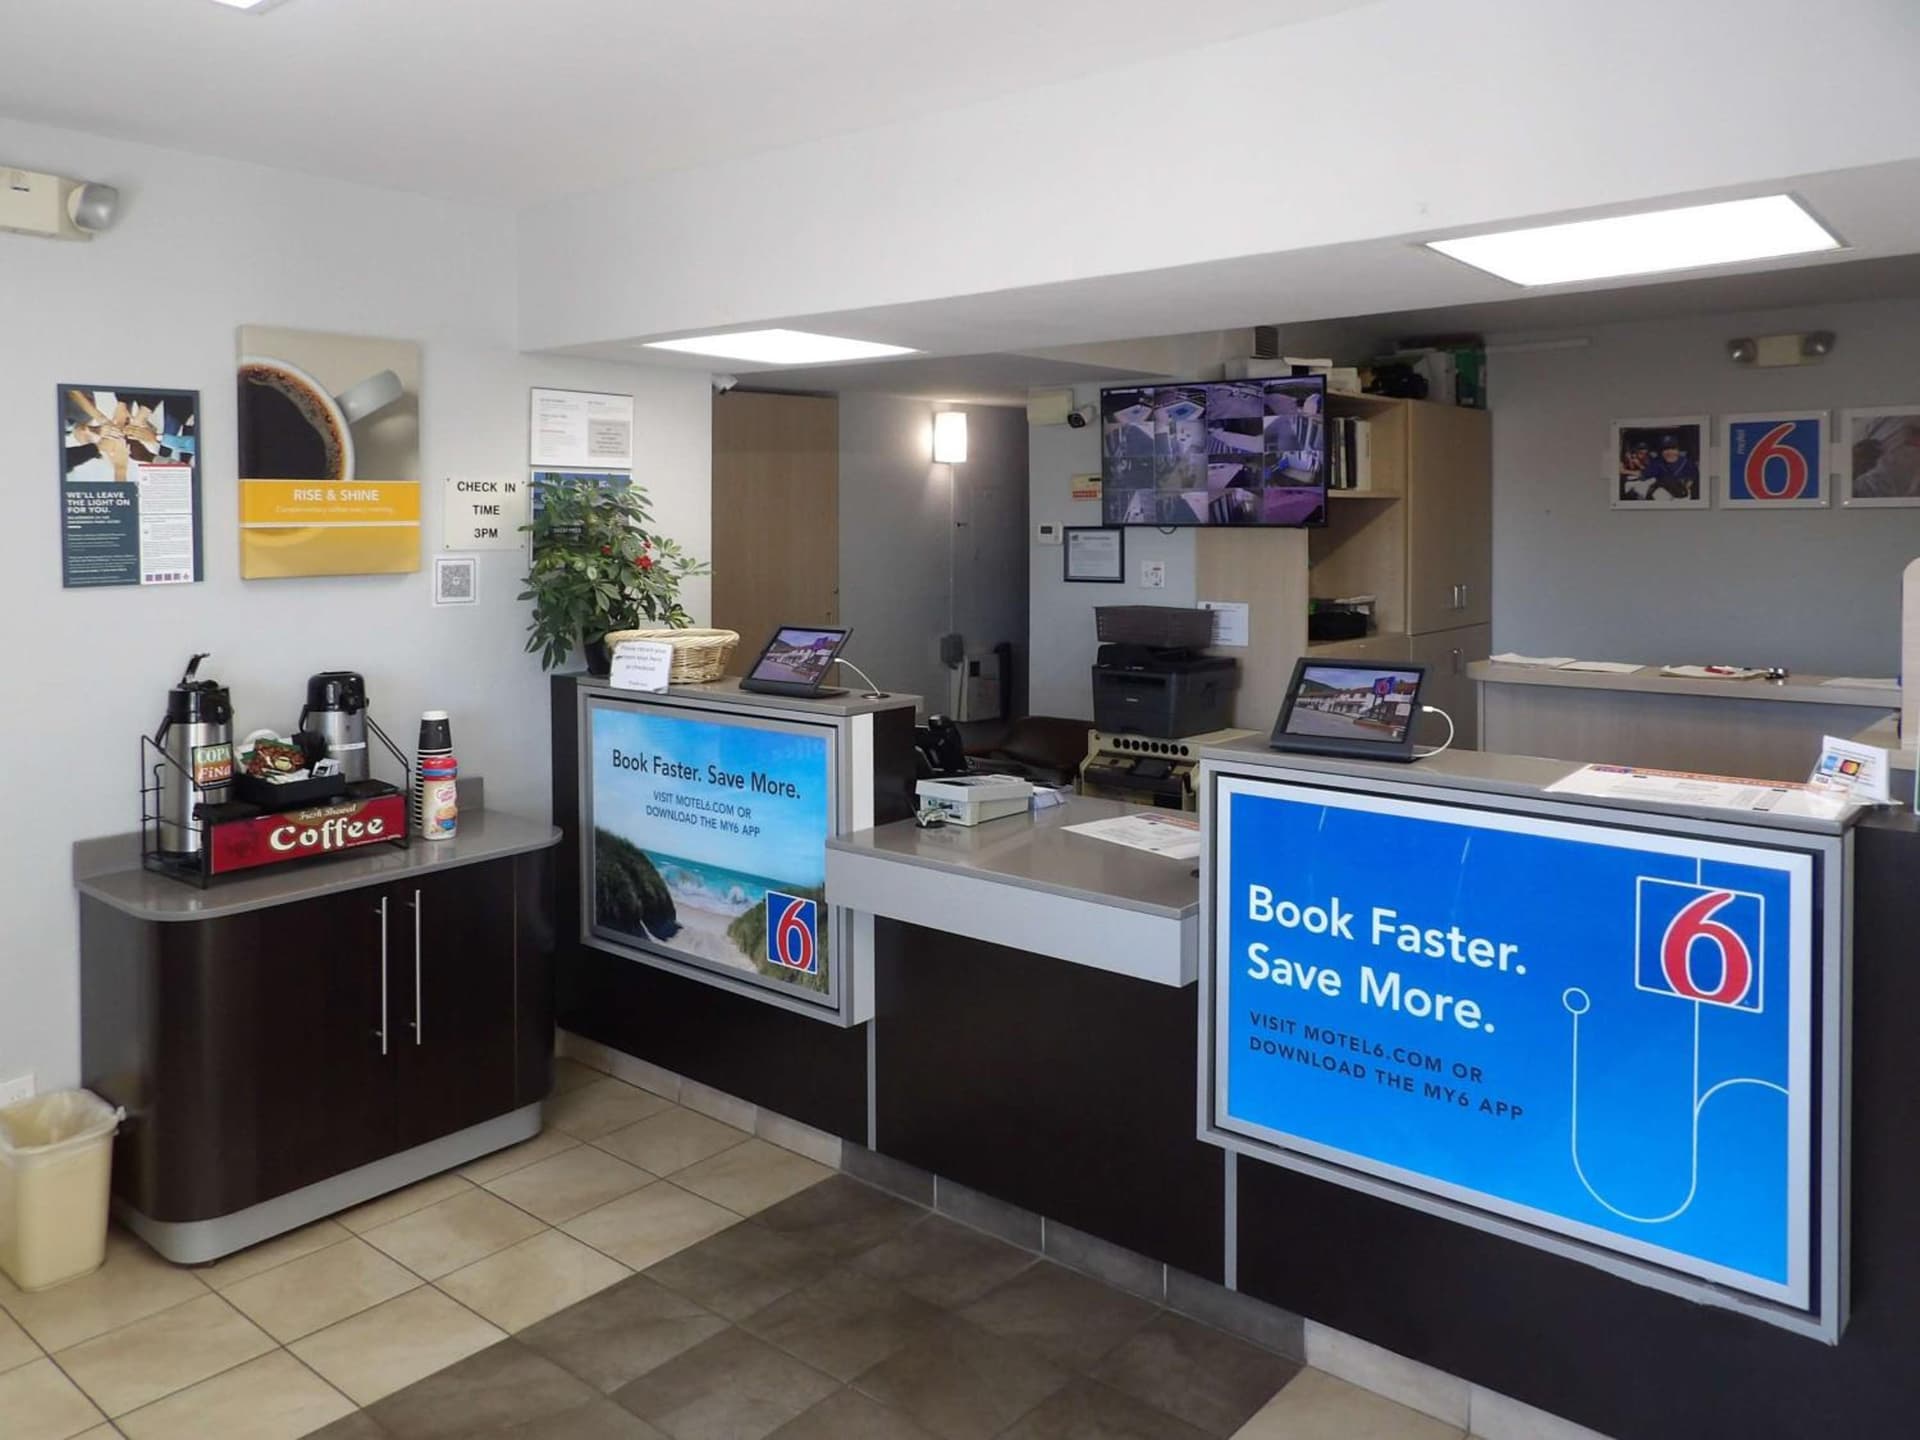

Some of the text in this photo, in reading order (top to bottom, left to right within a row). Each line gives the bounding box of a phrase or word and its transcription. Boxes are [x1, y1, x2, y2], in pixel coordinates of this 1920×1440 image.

[1744, 422, 1808, 499] 6
[97, 491, 125, 499] LEAVE
[294, 489, 379, 501] RISE & SHINE
[457, 481, 516, 494] CHECK IN
[473, 505, 500, 515] TIME
[474, 528, 498, 539] 3PM
[612, 749, 801, 799] Book Faster. Save More.
[646, 805, 760, 838] DOWNLOAD THE MY6 APP
[653, 791, 751, 819] VISIT MOTEL6.COM OR
[270, 817, 384, 851] Coffee
[776, 899, 814, 971] 6
[1248, 884, 1527, 975] Book Faster.
[1660, 889, 1753, 1007] 6
[1247, 944, 1496, 1033] Save More.
[1249, 1011, 1484, 1084] VISIT MOTEL6.COM OR
[1249, 1036, 1526, 1122] DOWNLOAD THE MY6 APP
